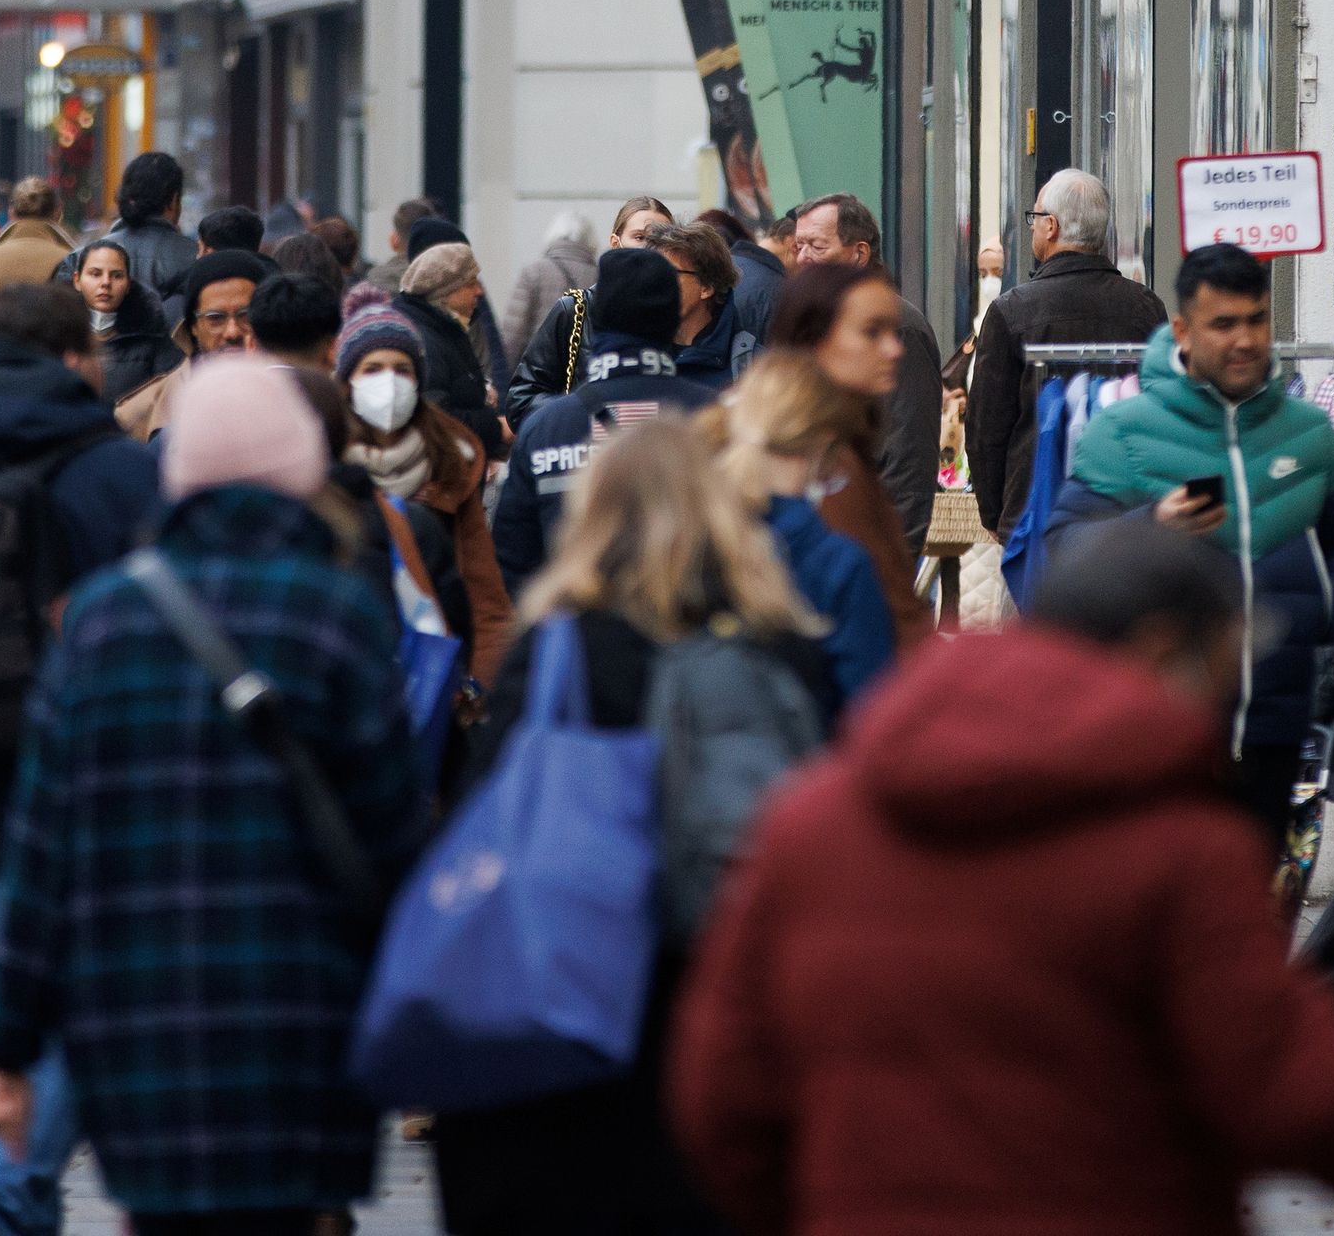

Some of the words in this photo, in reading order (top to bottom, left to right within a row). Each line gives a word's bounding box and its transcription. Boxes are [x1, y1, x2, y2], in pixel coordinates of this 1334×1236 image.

[770, 0, 831, 13] MENSCH
[1203, 168, 1257, 185] Jedes
[1262, 164, 1297, 182] Teil
[1212, 197, 1291, 212] Sonderpreis
[1234, 223, 1298, 248] 19,90
